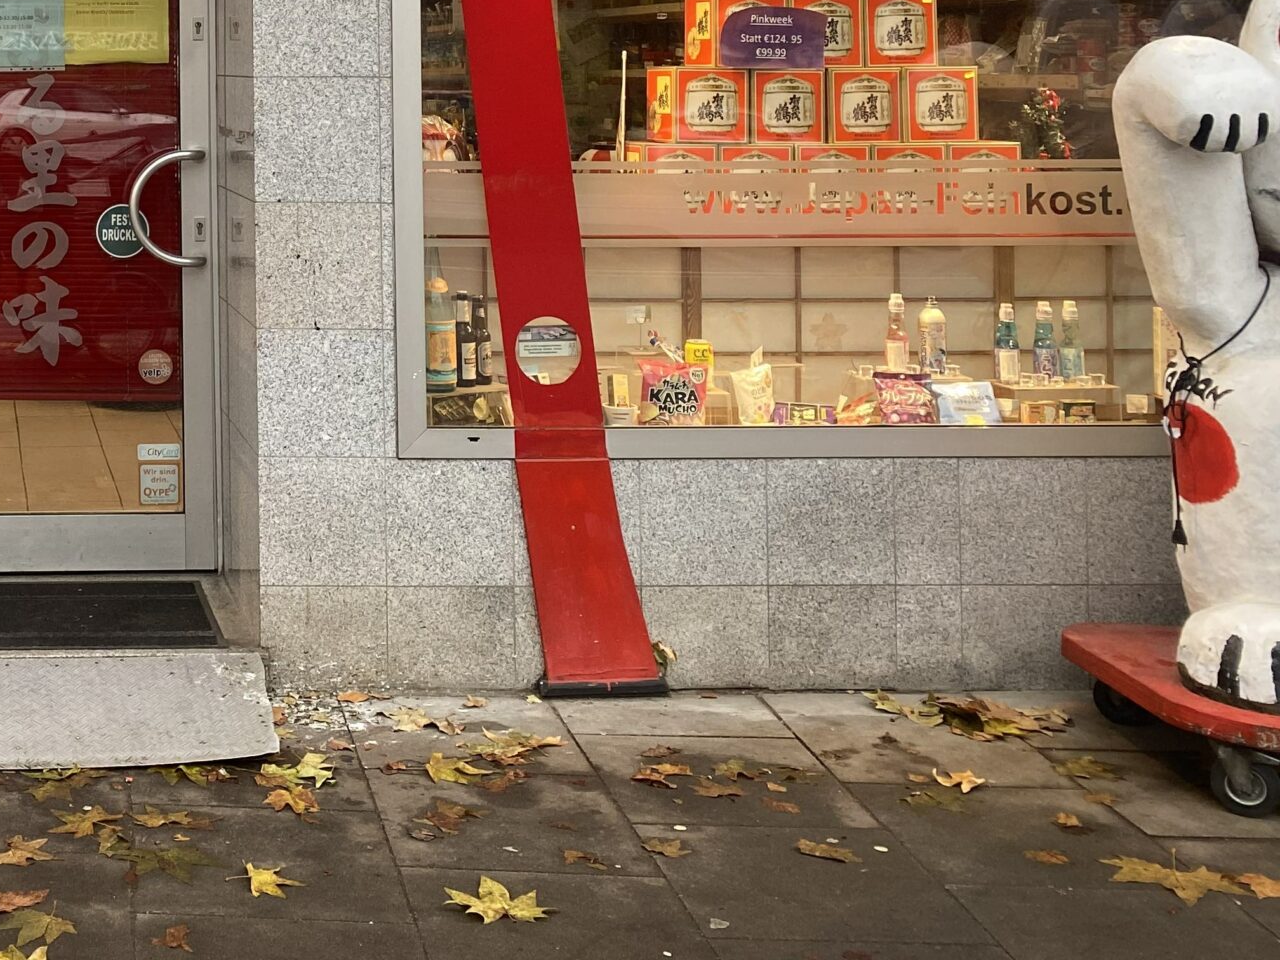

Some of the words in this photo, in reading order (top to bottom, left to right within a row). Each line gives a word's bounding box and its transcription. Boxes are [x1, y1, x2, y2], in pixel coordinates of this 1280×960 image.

[750, 14, 793, 26] Pinkweek
[740, 33, 763, 44] Statt
[756, 47, 787, 58] €99.99
[683, 181, 1128, 223] www.Japan-Feinkost.
[102, 227, 138, 242] DRÜCKE
[143, 368, 162, 377] yelp
[649, 389, 699, 405] KARA
[659, 404, 697, 415] MUCHO
[143, 486, 170, 499] QYPE
